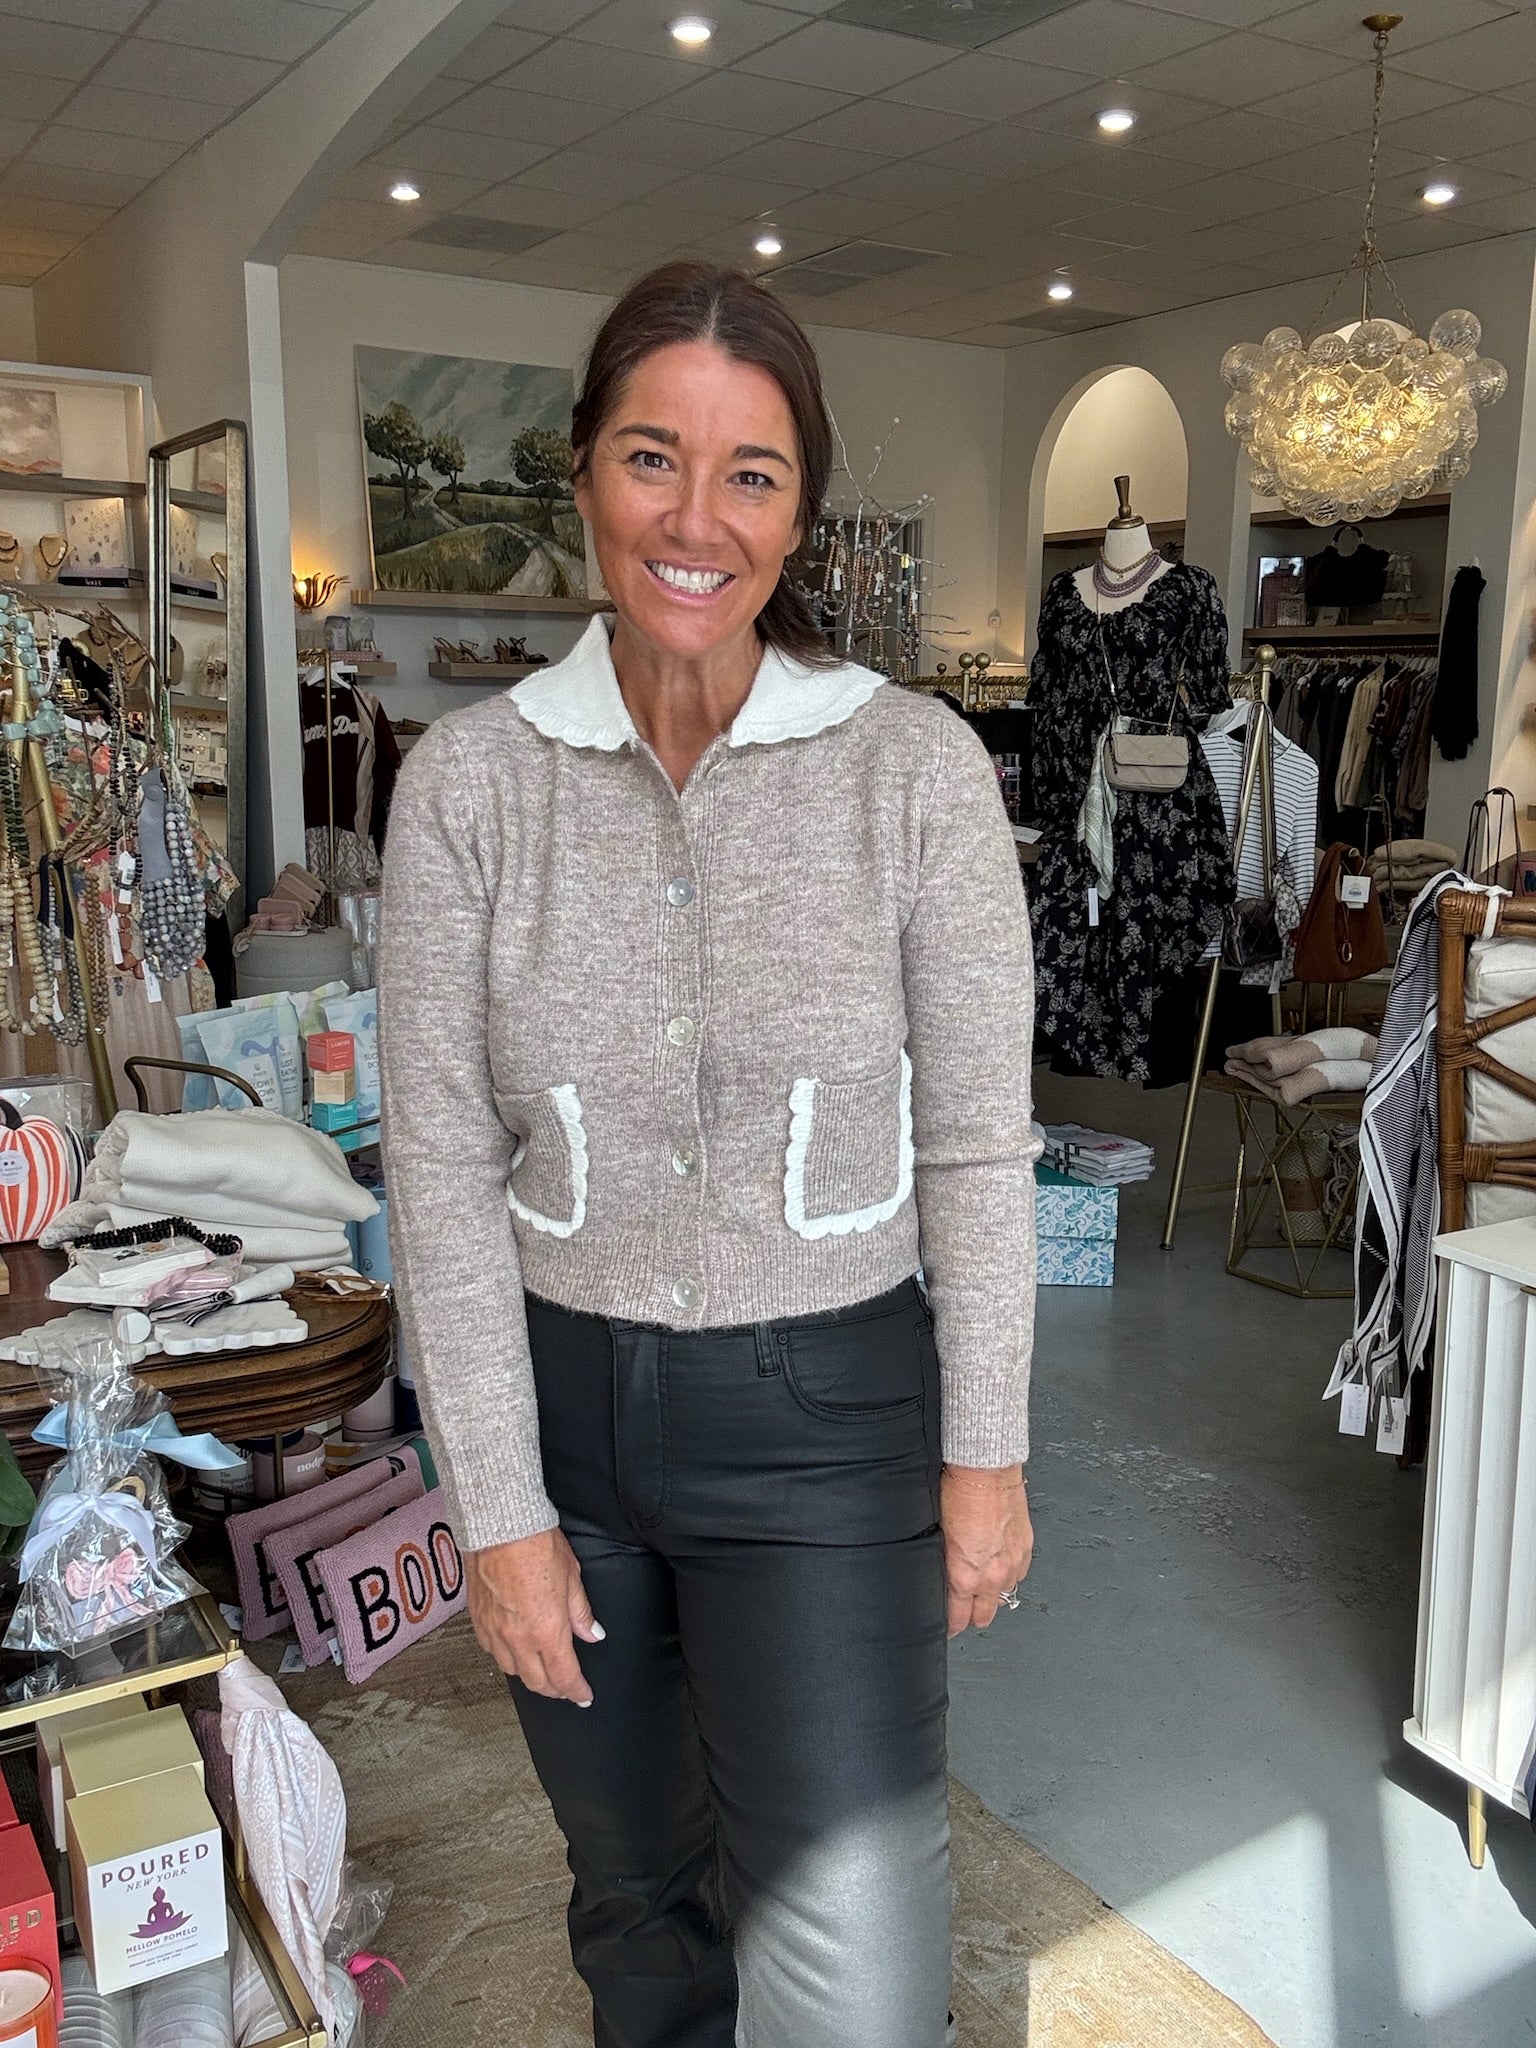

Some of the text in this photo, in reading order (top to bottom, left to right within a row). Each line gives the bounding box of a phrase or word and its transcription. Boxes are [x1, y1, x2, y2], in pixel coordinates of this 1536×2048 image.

[332, 715, 360, 737] Da
[349, 1521, 463, 1654] BOO
[101, 1843, 209, 1888] POURED
[125, 1867, 189, 1894] NEW YORK
[0, 1909, 42, 1938] ED
[126, 1938, 162, 1954] MELLOW
[163, 1926, 198, 1943] POMELO
